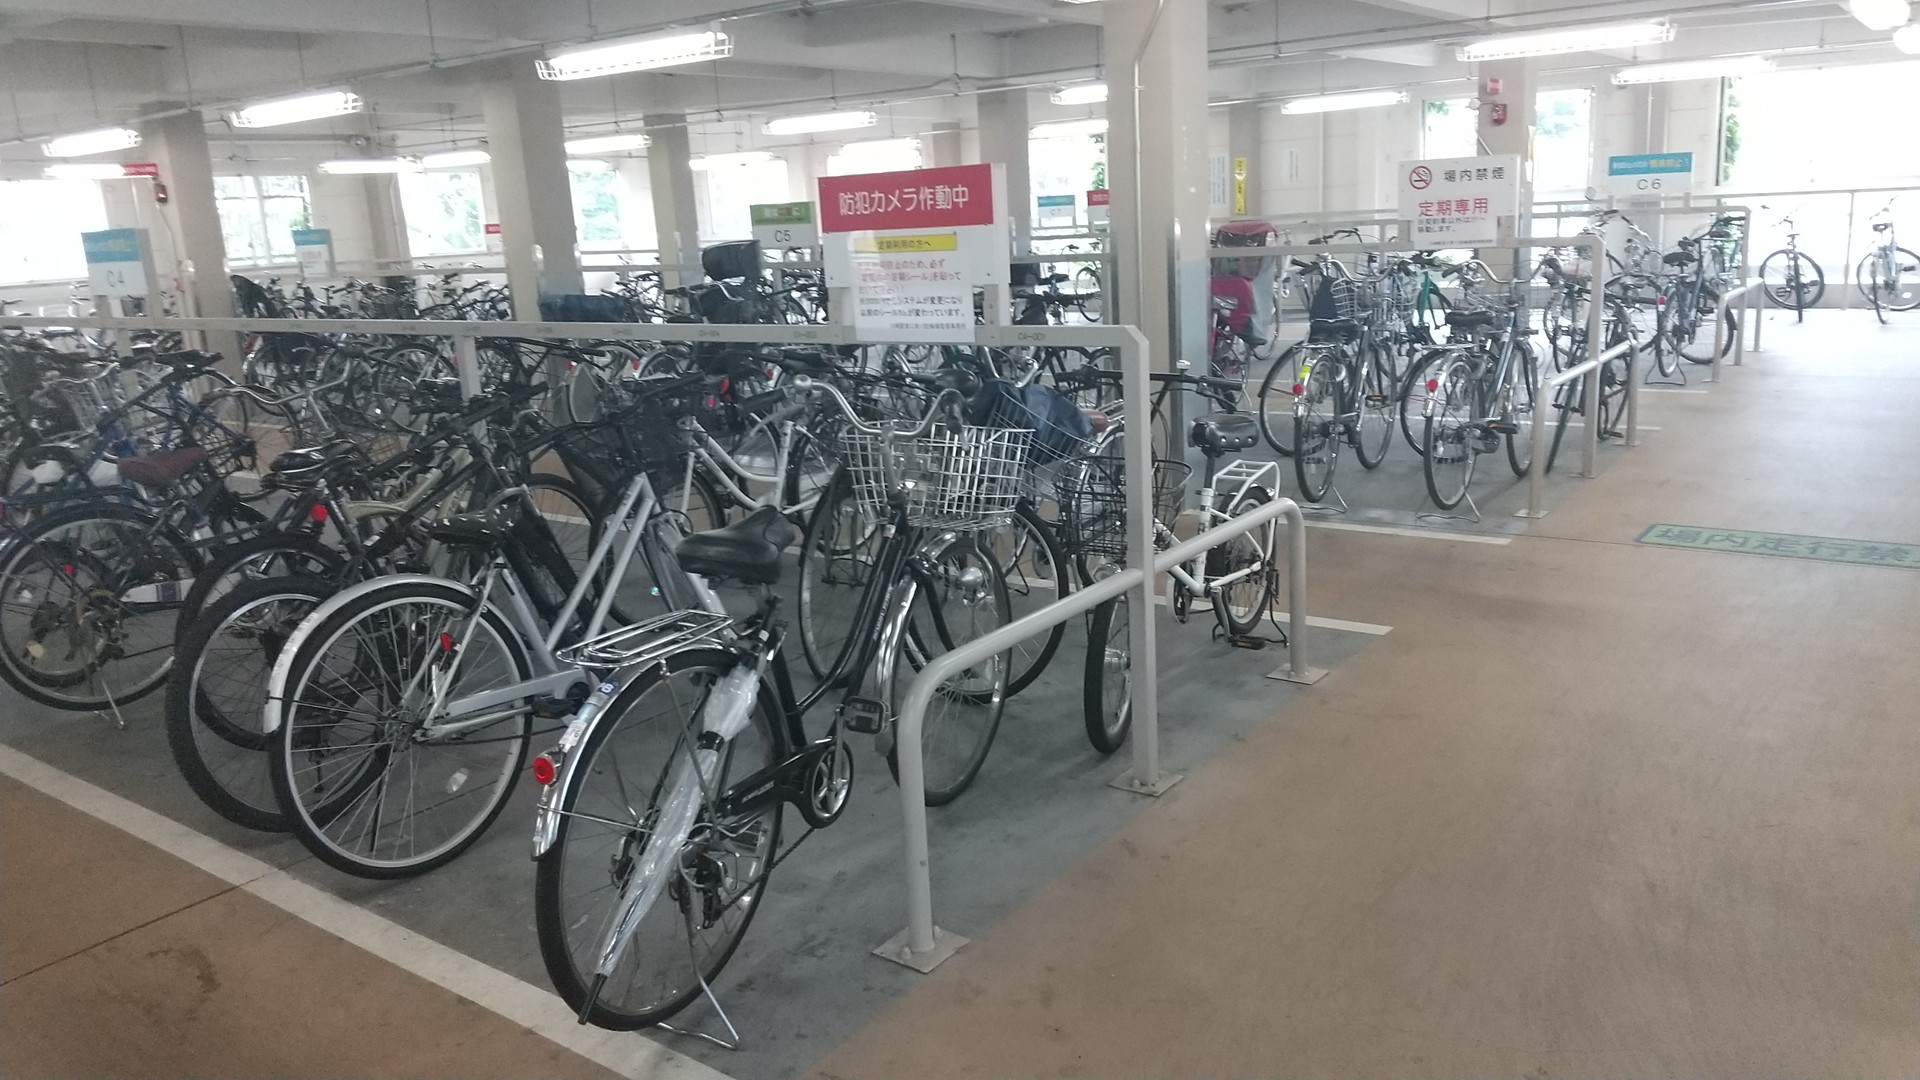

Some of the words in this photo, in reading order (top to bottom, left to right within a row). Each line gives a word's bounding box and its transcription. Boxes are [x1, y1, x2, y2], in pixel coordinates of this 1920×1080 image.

[1444, 167, 1504, 182] 場内禁煙
[1637, 178, 1661, 190] C6
[839, 184, 969, 216] 防犯カメラ作動中
[1419, 198, 1488, 217] 定期専用
[775, 229, 791, 242] C5
[1654, 528, 1919, 562] 場内走行禁
